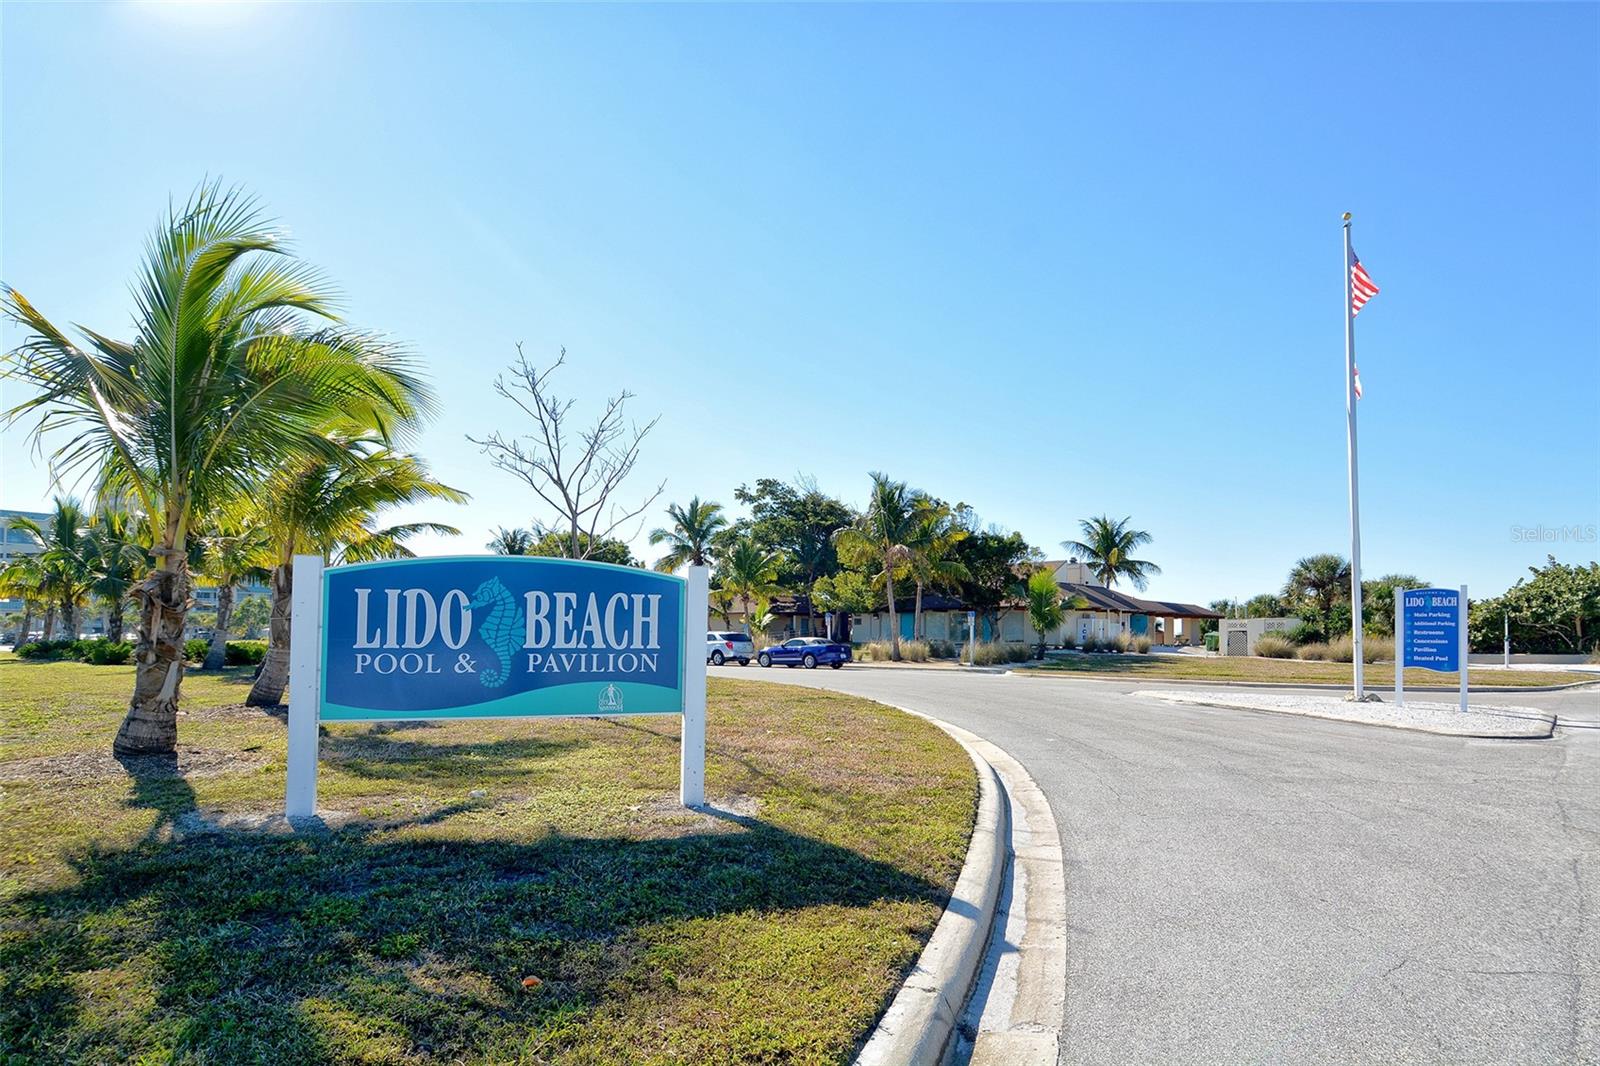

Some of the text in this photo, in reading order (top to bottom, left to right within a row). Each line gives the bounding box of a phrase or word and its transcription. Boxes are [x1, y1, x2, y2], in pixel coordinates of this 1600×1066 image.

[1405, 596, 1457, 608] LIDO BEACH
[353, 588, 662, 650] LIDO BEACH
[354, 652, 659, 675] POOL & PAVILION
